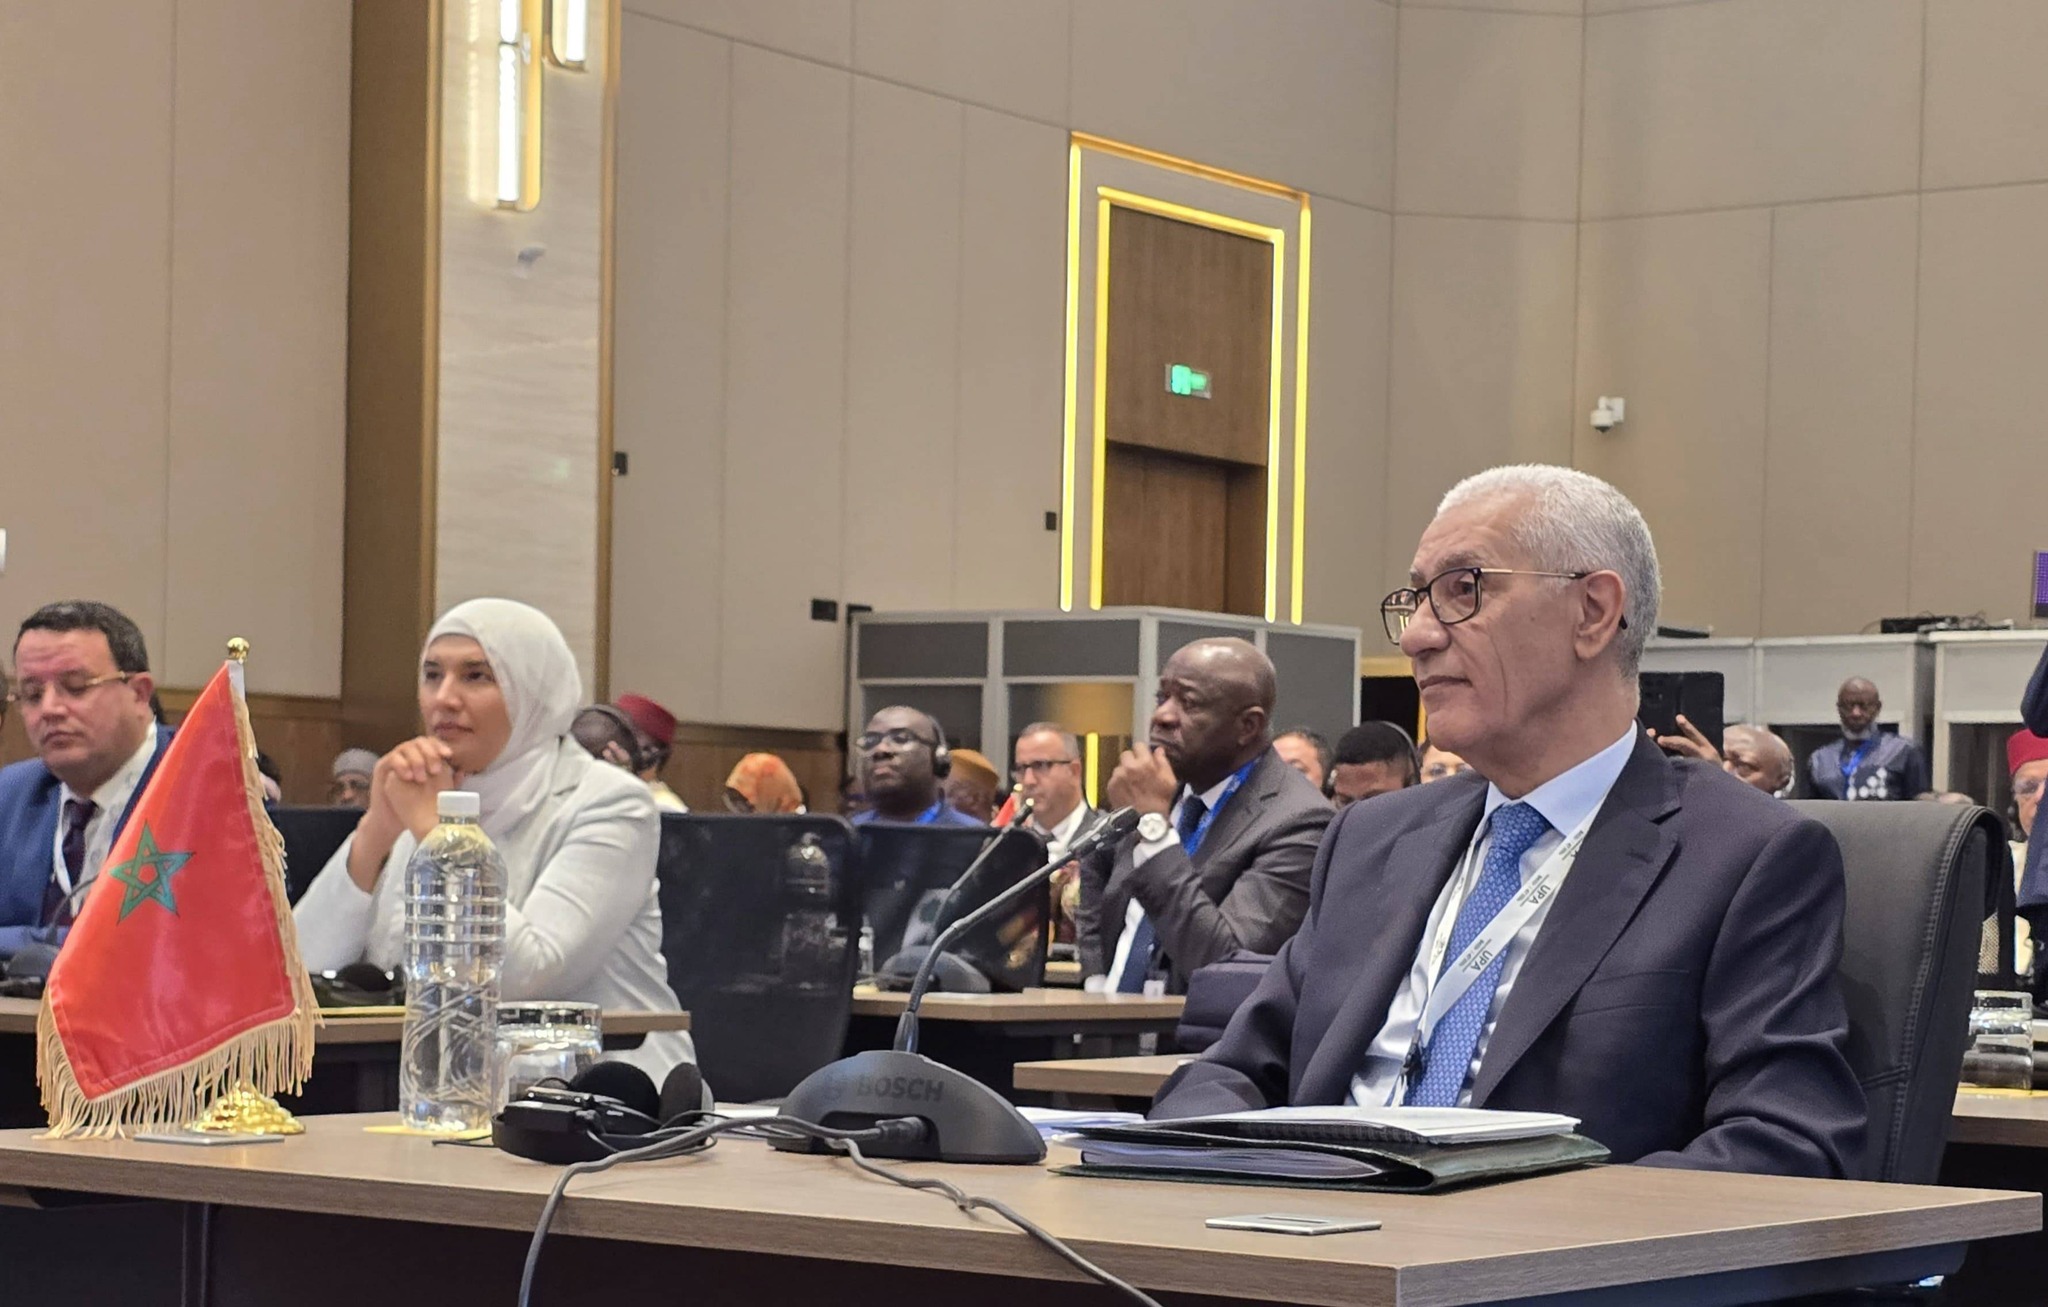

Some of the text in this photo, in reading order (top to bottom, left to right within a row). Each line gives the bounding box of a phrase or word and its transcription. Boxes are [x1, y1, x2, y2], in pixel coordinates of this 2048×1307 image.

[1529, 884, 1551, 904] UPA
[1470, 950, 1493, 971] UPA
[857, 1076, 945, 1101] BOSCH
